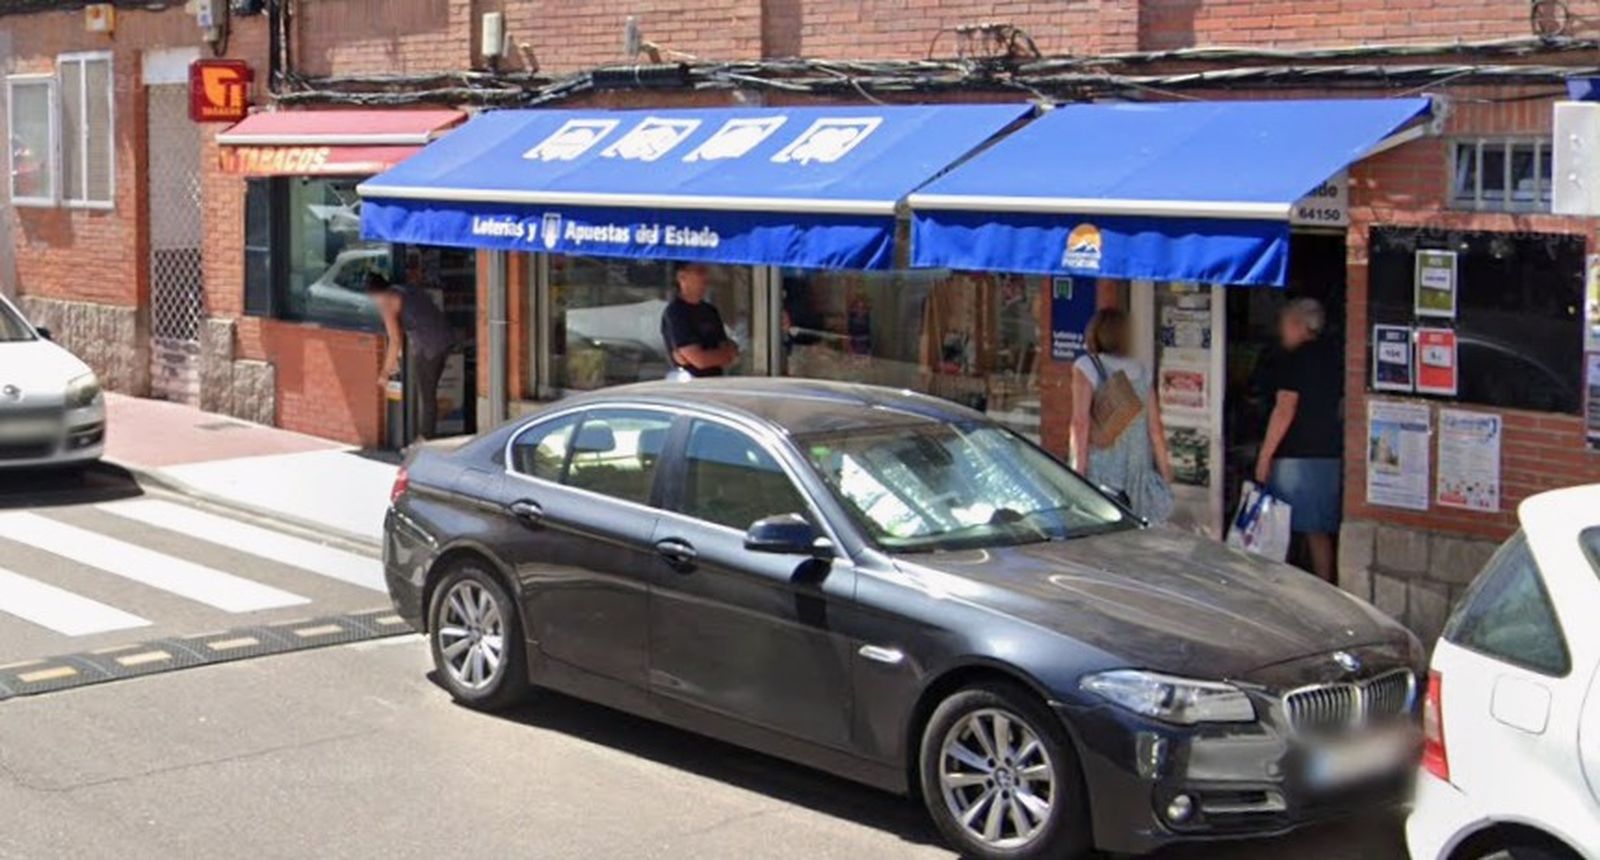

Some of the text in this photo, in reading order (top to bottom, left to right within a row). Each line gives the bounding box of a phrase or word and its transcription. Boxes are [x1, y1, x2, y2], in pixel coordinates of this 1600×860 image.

[236, 147, 331, 172] TABACOS
[1299, 207, 1341, 221] 64150
[527, 221, 538, 242] y
[564, 221, 631, 244] Apuestas
[635, 224, 660, 244] del
[664, 225, 719, 247] Estado
